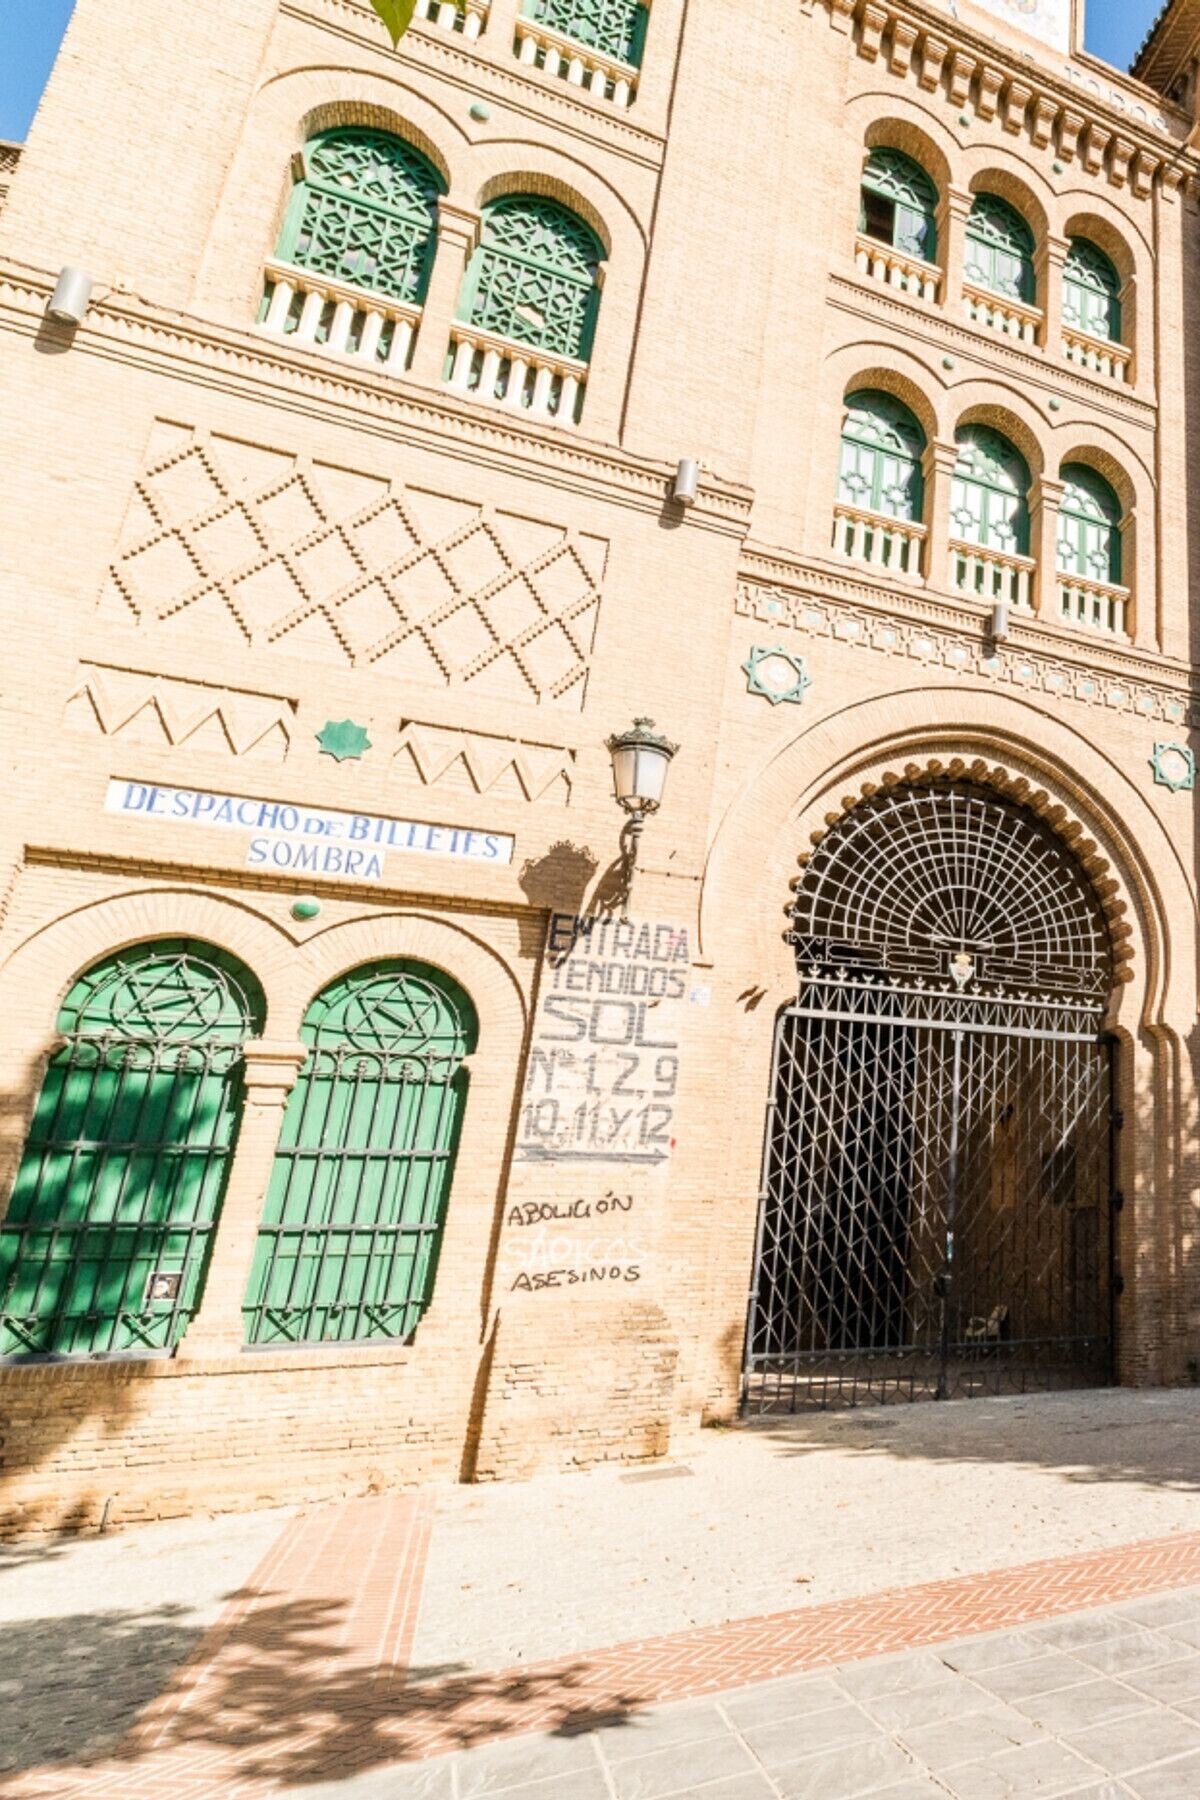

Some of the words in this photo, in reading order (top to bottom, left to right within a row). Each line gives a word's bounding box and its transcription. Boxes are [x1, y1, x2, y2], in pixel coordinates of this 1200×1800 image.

[121, 783, 299, 833] DESPACHO
[303, 817, 345, 839] DE
[347, 815, 499, 860] BILLETES
[248, 838, 383, 879] SOMBRA
[548, 912, 690, 964] ENTRADA
[551, 957, 687, 999] TENDIDOS
[539, 993, 678, 1049] SOL
[652, 1054, 679, 1098] 9
[636, 1103, 673, 1145] 12
[510, 1265, 641, 1292] ASESINOS
